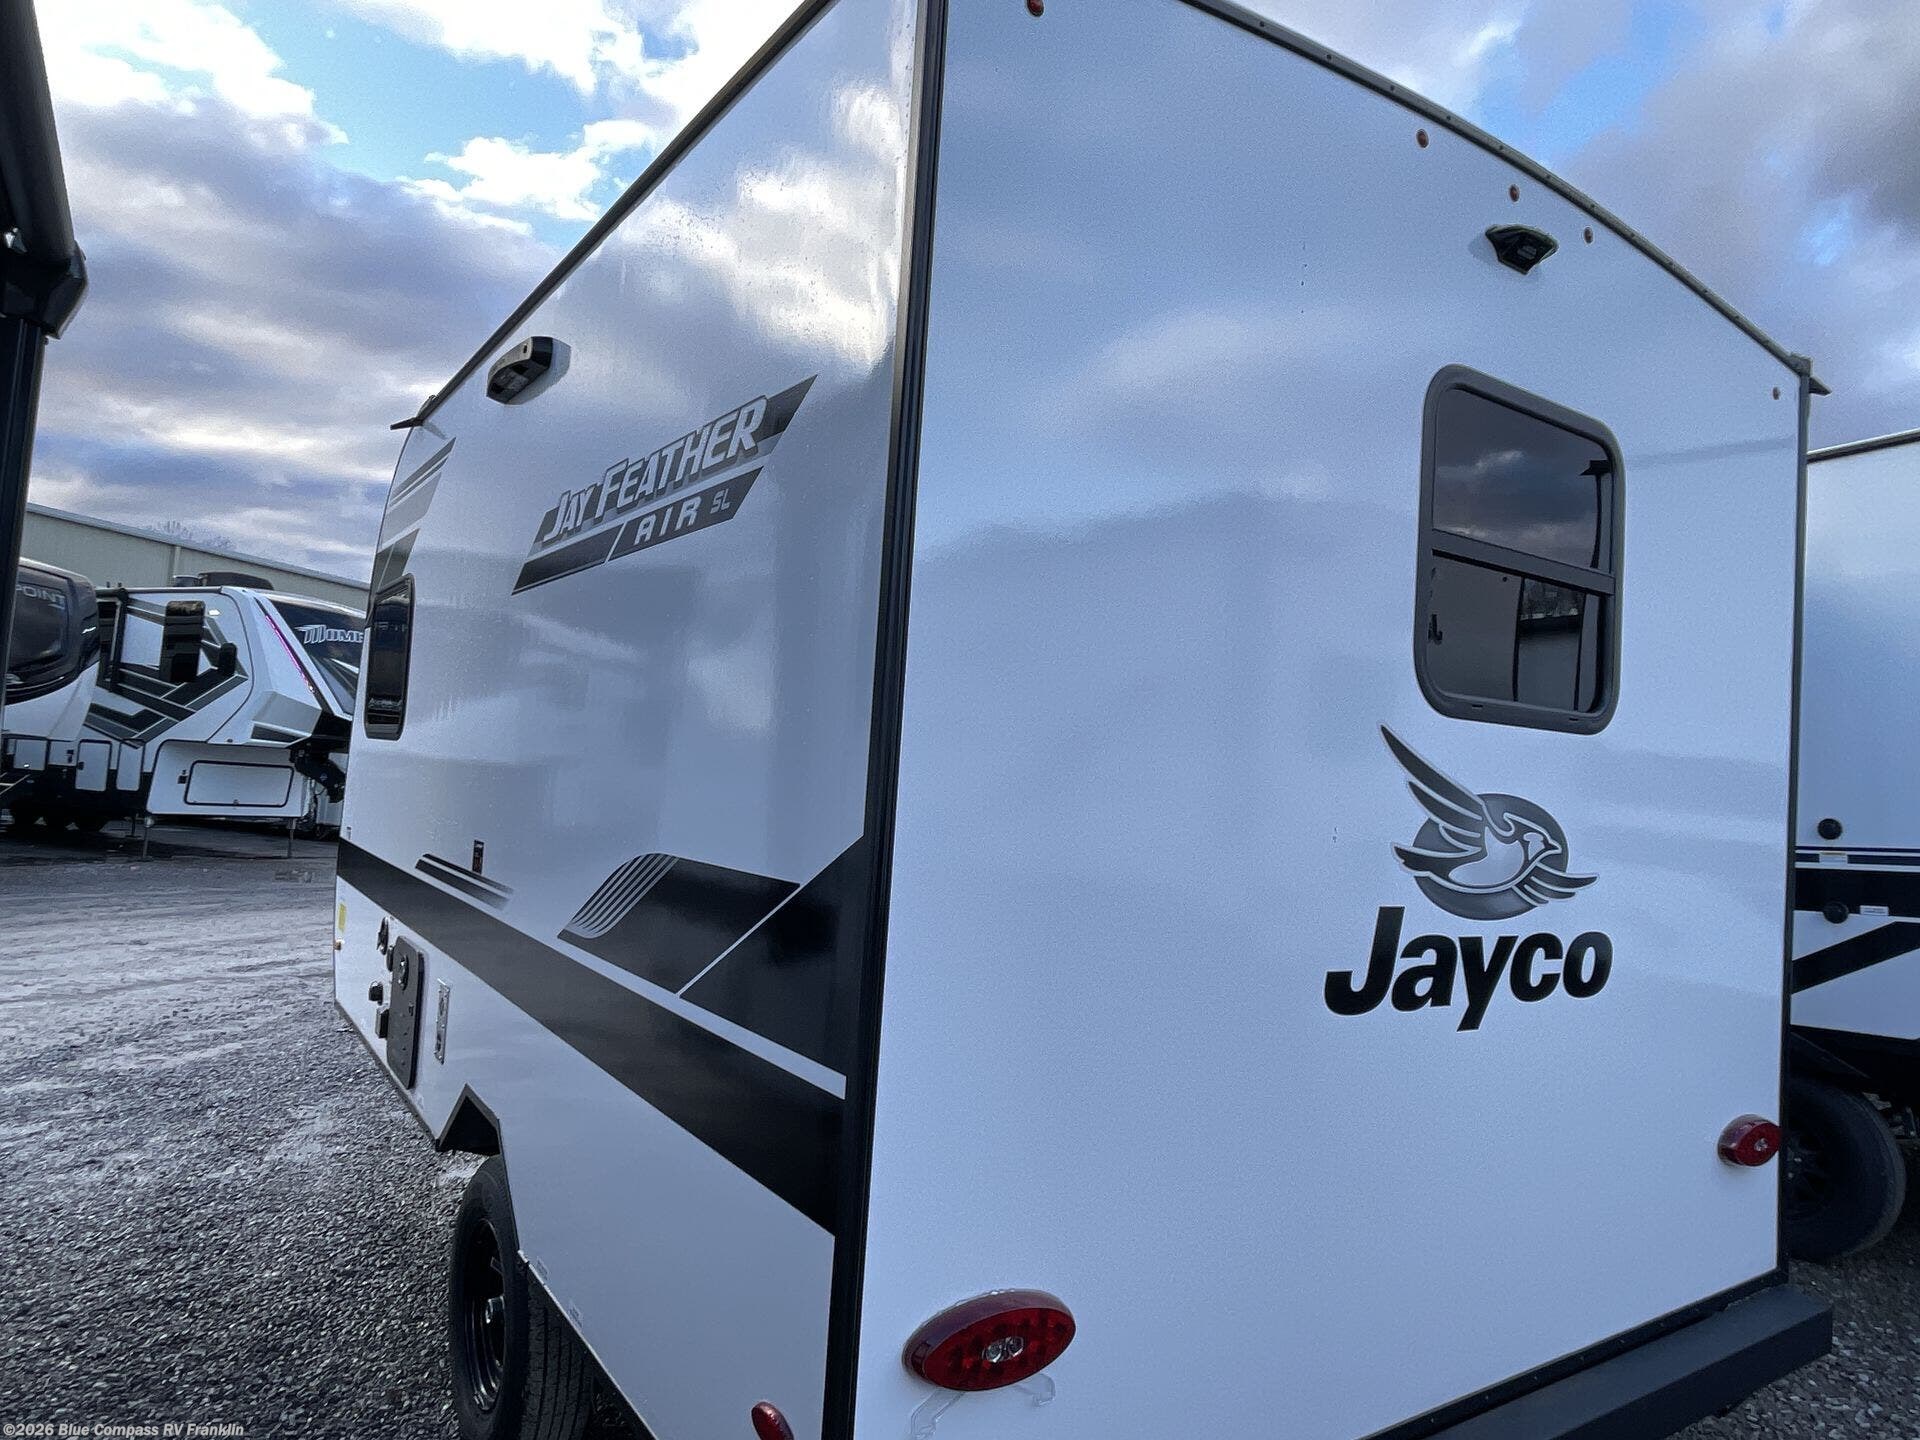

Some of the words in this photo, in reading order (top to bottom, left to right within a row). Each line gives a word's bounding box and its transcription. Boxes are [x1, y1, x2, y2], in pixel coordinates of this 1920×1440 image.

[541, 484, 598, 544] JAY
[595, 395, 768, 522] FEATHER
[633, 496, 703, 546] AIR
[709, 488, 731, 515] SL
[1324, 905, 1613, 1032] Jayco
